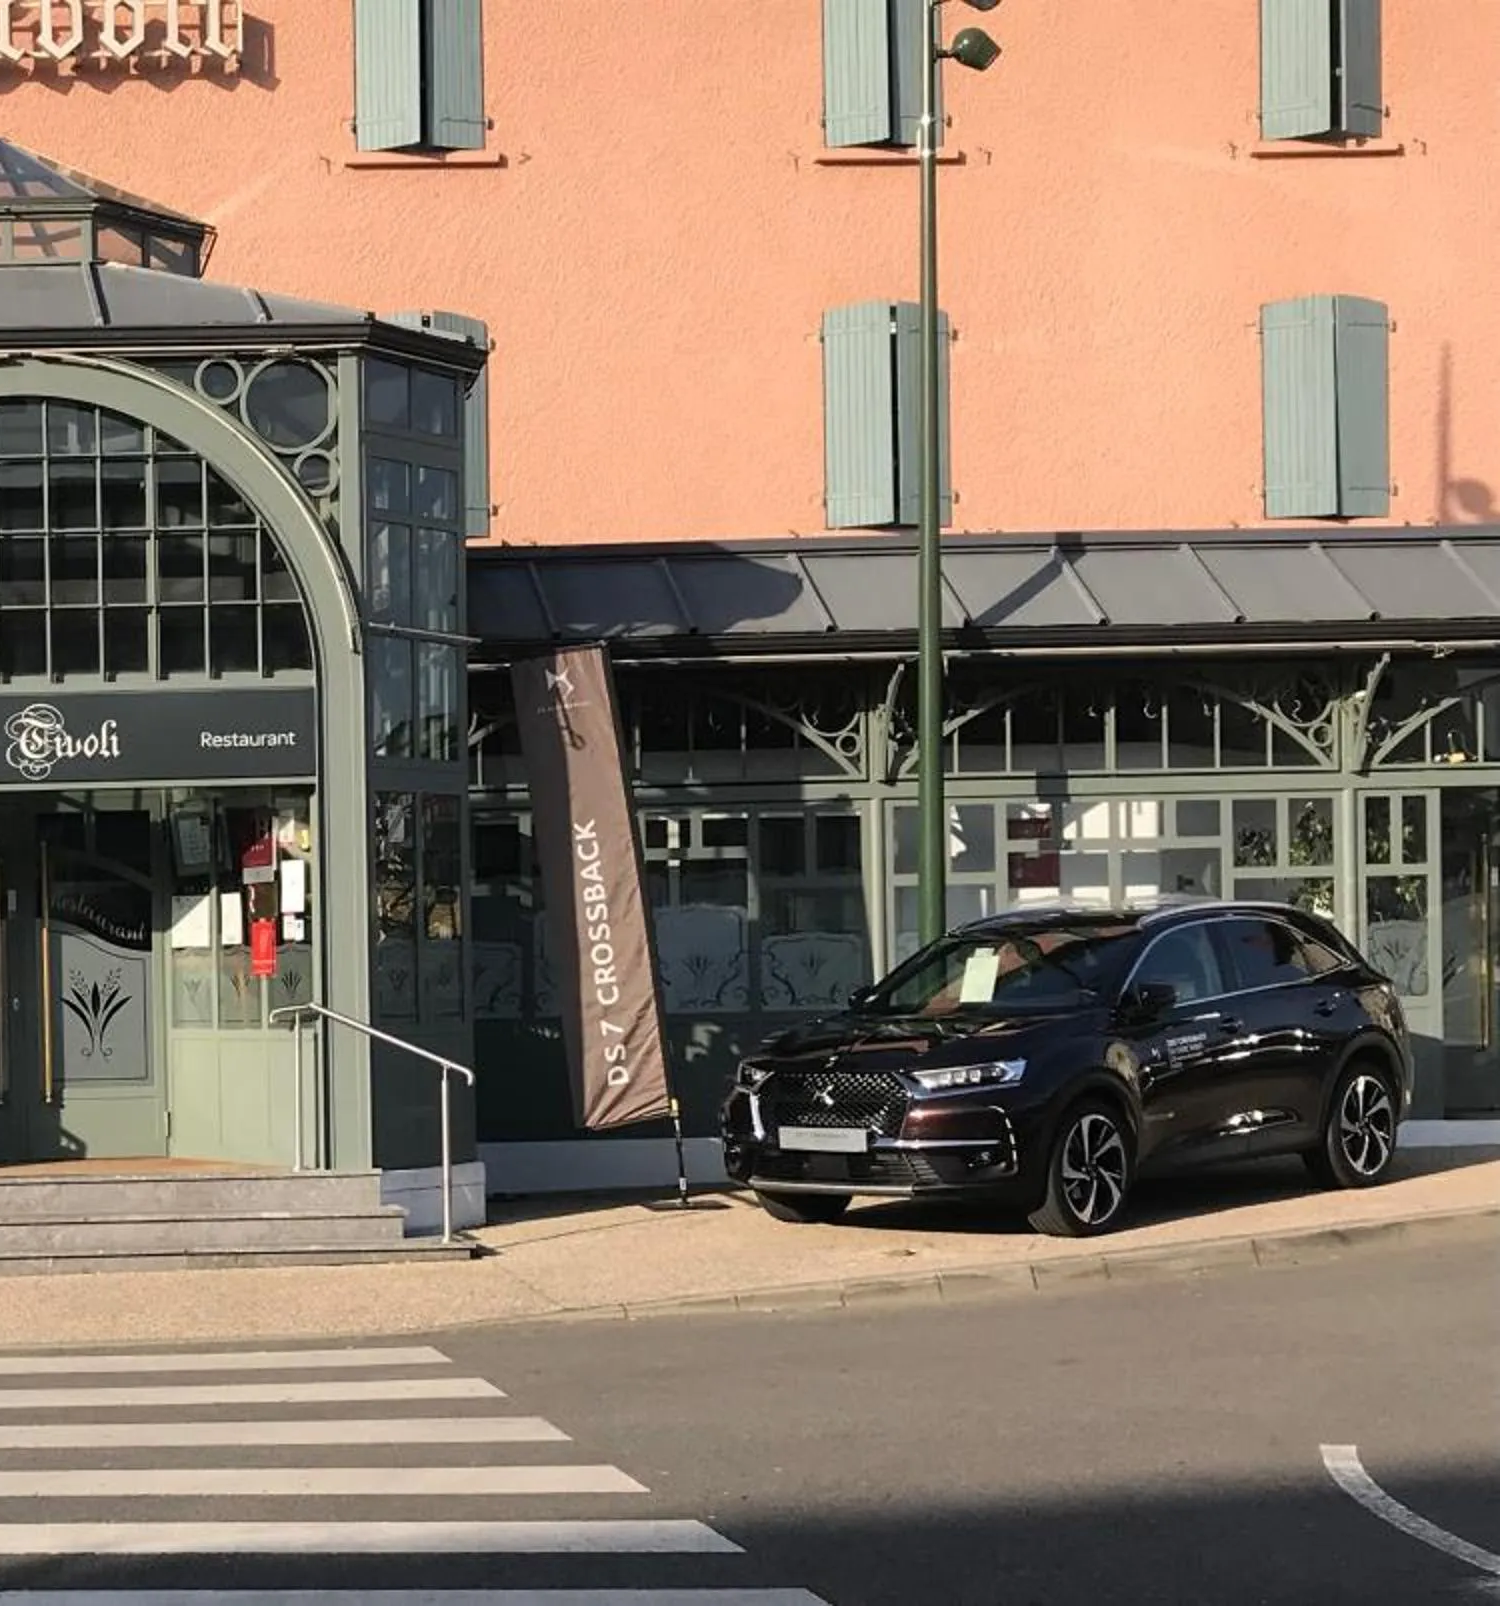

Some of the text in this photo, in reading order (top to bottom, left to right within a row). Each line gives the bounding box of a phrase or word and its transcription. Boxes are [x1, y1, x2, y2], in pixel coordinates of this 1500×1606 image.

[4, 703, 121, 781] Tivoli
[200, 731, 296, 748] Restaurant
[573, 818, 630, 1086] DS 7 CROSSBACK
